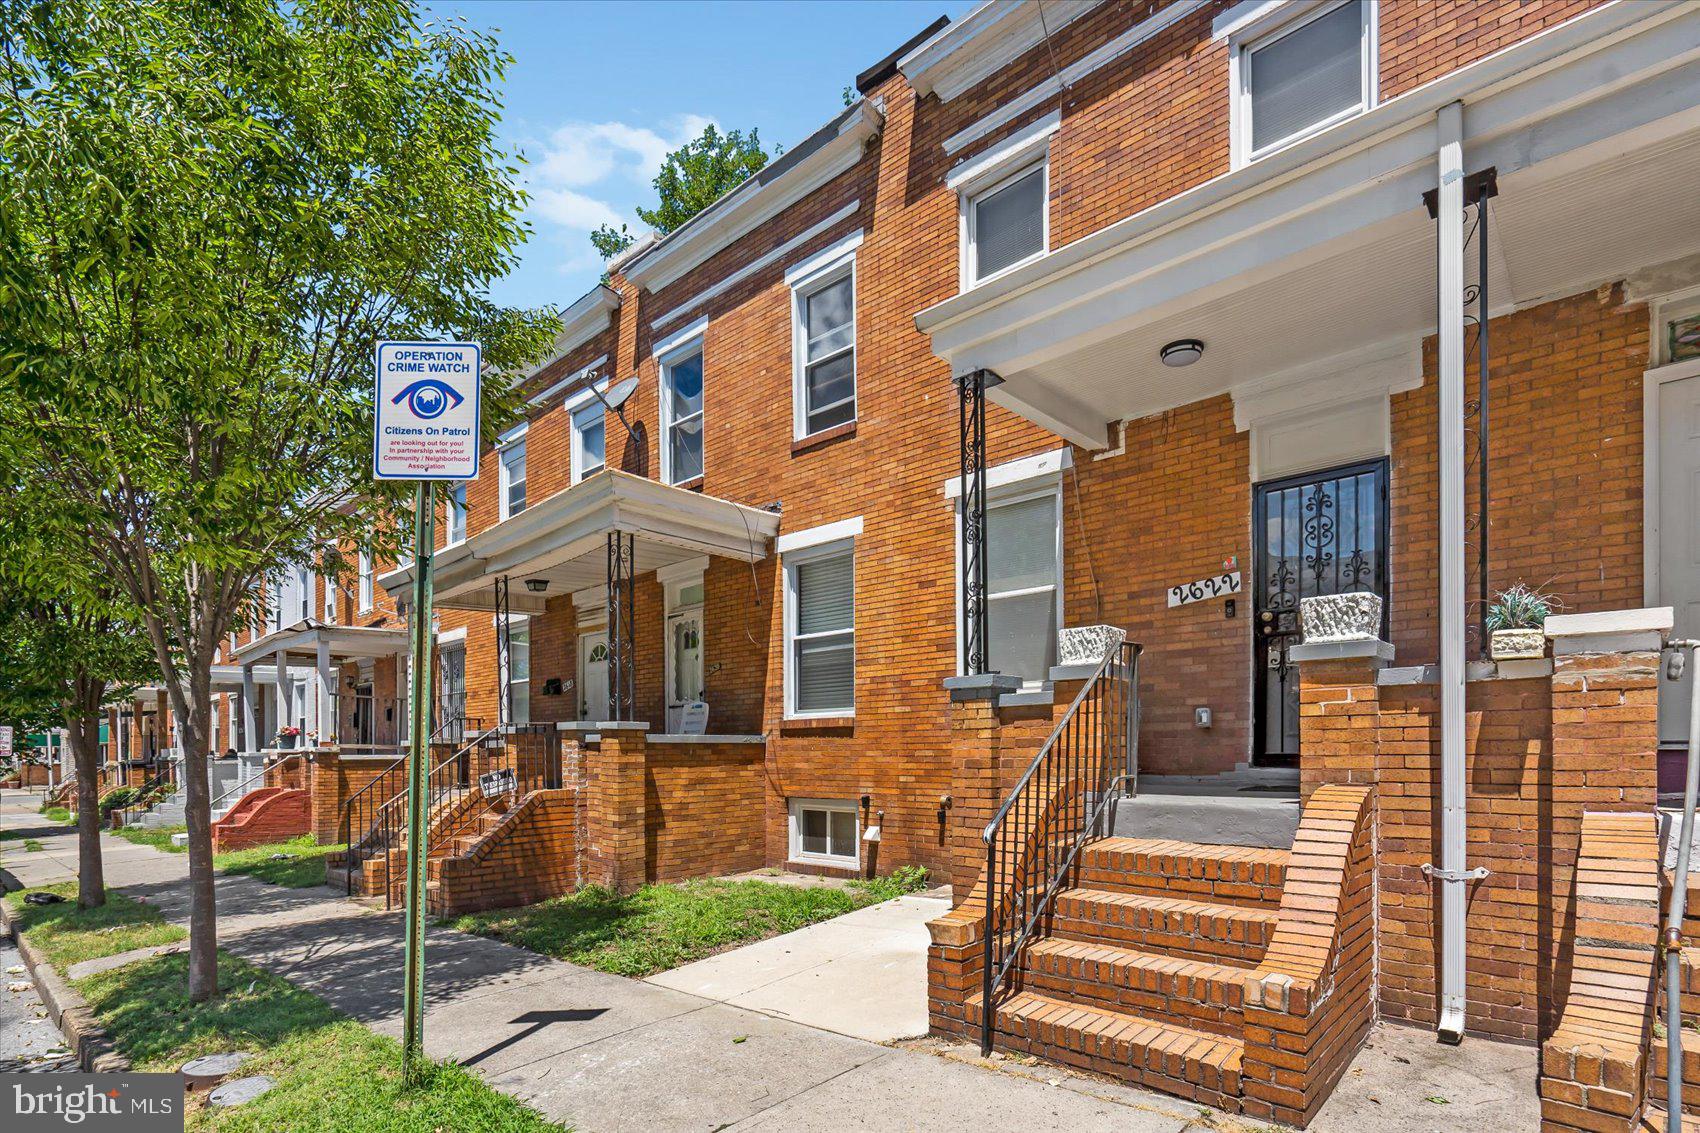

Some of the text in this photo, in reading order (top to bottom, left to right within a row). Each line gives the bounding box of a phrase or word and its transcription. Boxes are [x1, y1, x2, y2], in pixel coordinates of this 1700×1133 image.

[395, 351, 463, 361] OPERATION
[387, 362, 470, 373] CRIME WATCH
[385, 426, 470, 436] Citizens On Patrol
[397, 447, 433, 455] partnership
[383, 455, 419, 463] Community
[1172, 573, 1240, 605] 2622
